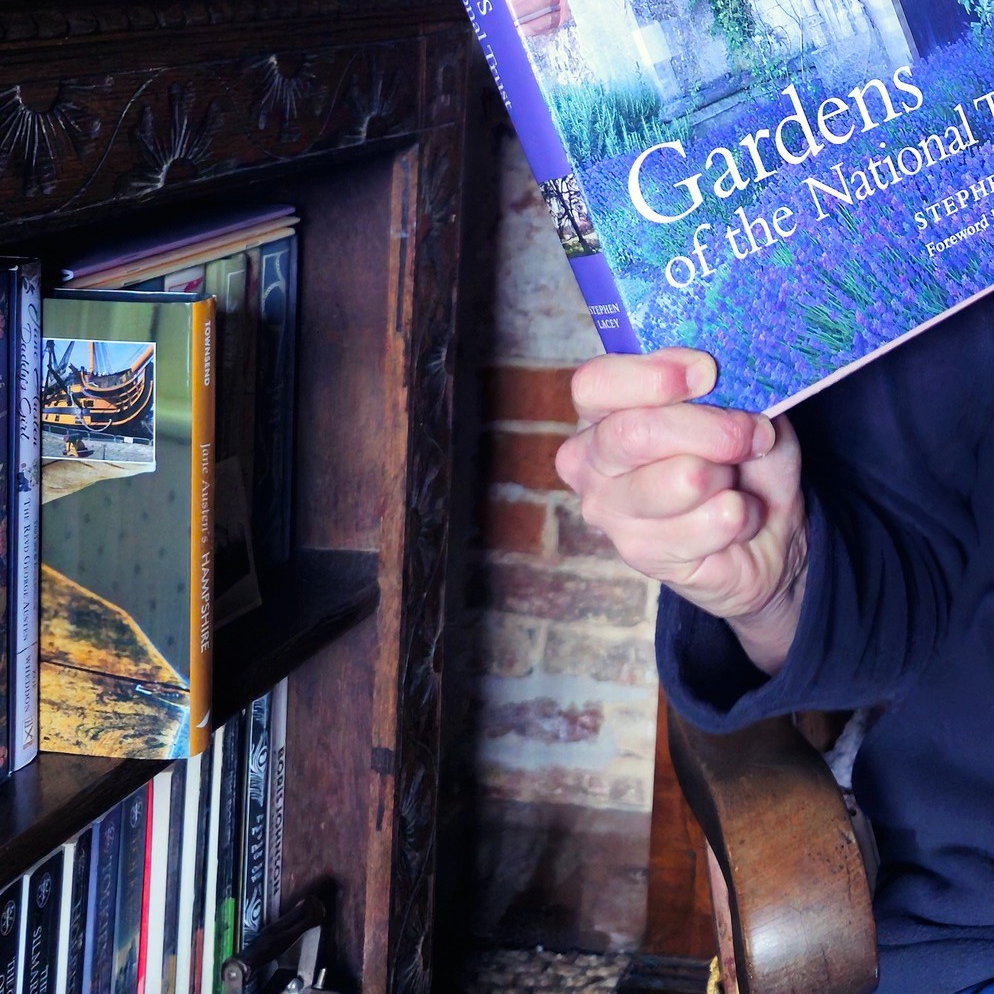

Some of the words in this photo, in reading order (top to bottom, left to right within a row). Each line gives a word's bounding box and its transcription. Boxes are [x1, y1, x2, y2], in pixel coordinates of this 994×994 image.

[627, 65, 925, 225] Gardens
[664, 227, 717, 289] of
[725, 204, 798, 263] the
[802, 103, 980, 221] National
[925, 213, 990, 257] Foreword
[590, 303, 620, 315] STEPHEN
[597, 318, 620, 329] LACEY
[203, 320, 212, 387] TOWNSEND
[19, 397, 32, 441] Girl
[200, 443, 212, 474] Jane
[23, 497, 32, 520] THE
[200, 480, 212, 544] Austen's
[23, 525, 31, 553] REVD
[23, 555, 31, 598] GEORGE
[200, 551, 211, 653] HAMPSHIRE
[22, 601, 31, 642] AUSTEN
[24, 654, 32, 713] WHEDDON
[275, 746, 286, 804] BORIS
[272, 807, 284, 896] JOHNSON
[30, 925, 42, 994] SILMAR
